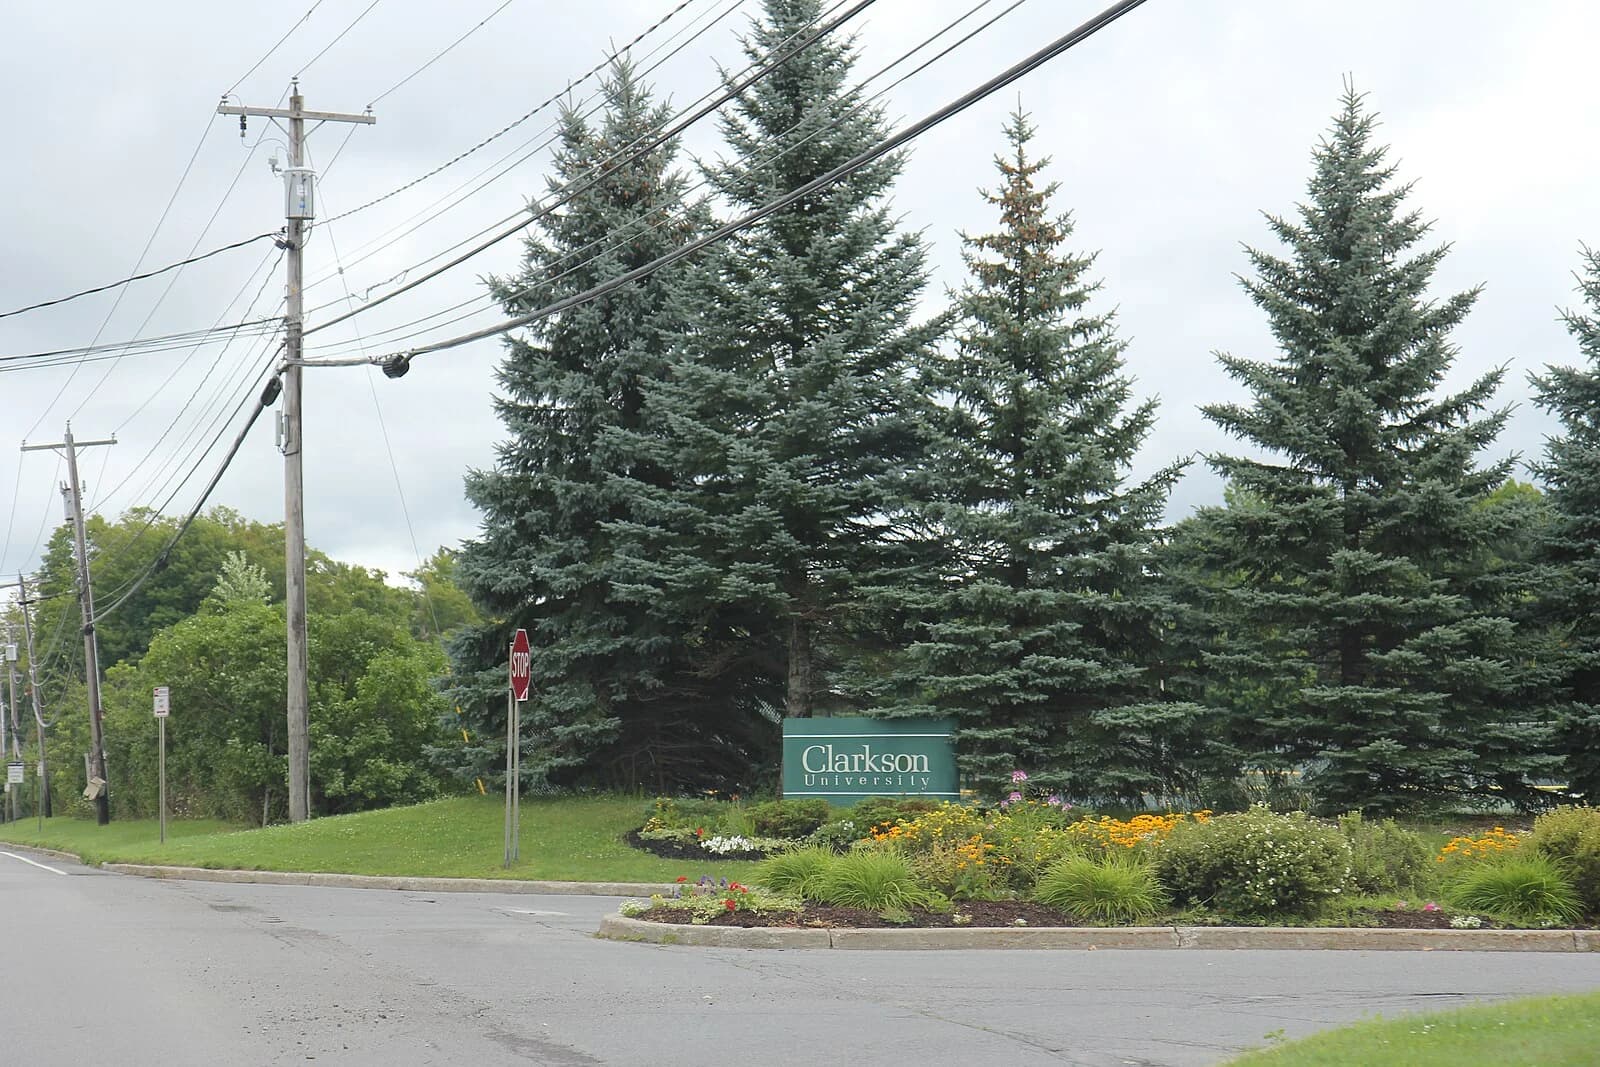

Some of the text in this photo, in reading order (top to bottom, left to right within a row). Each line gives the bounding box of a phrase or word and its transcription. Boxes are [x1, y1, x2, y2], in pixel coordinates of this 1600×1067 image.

[512, 652, 529, 678] STOP
[802, 744, 932, 774] Clarkson
[804, 774, 931, 791] University
